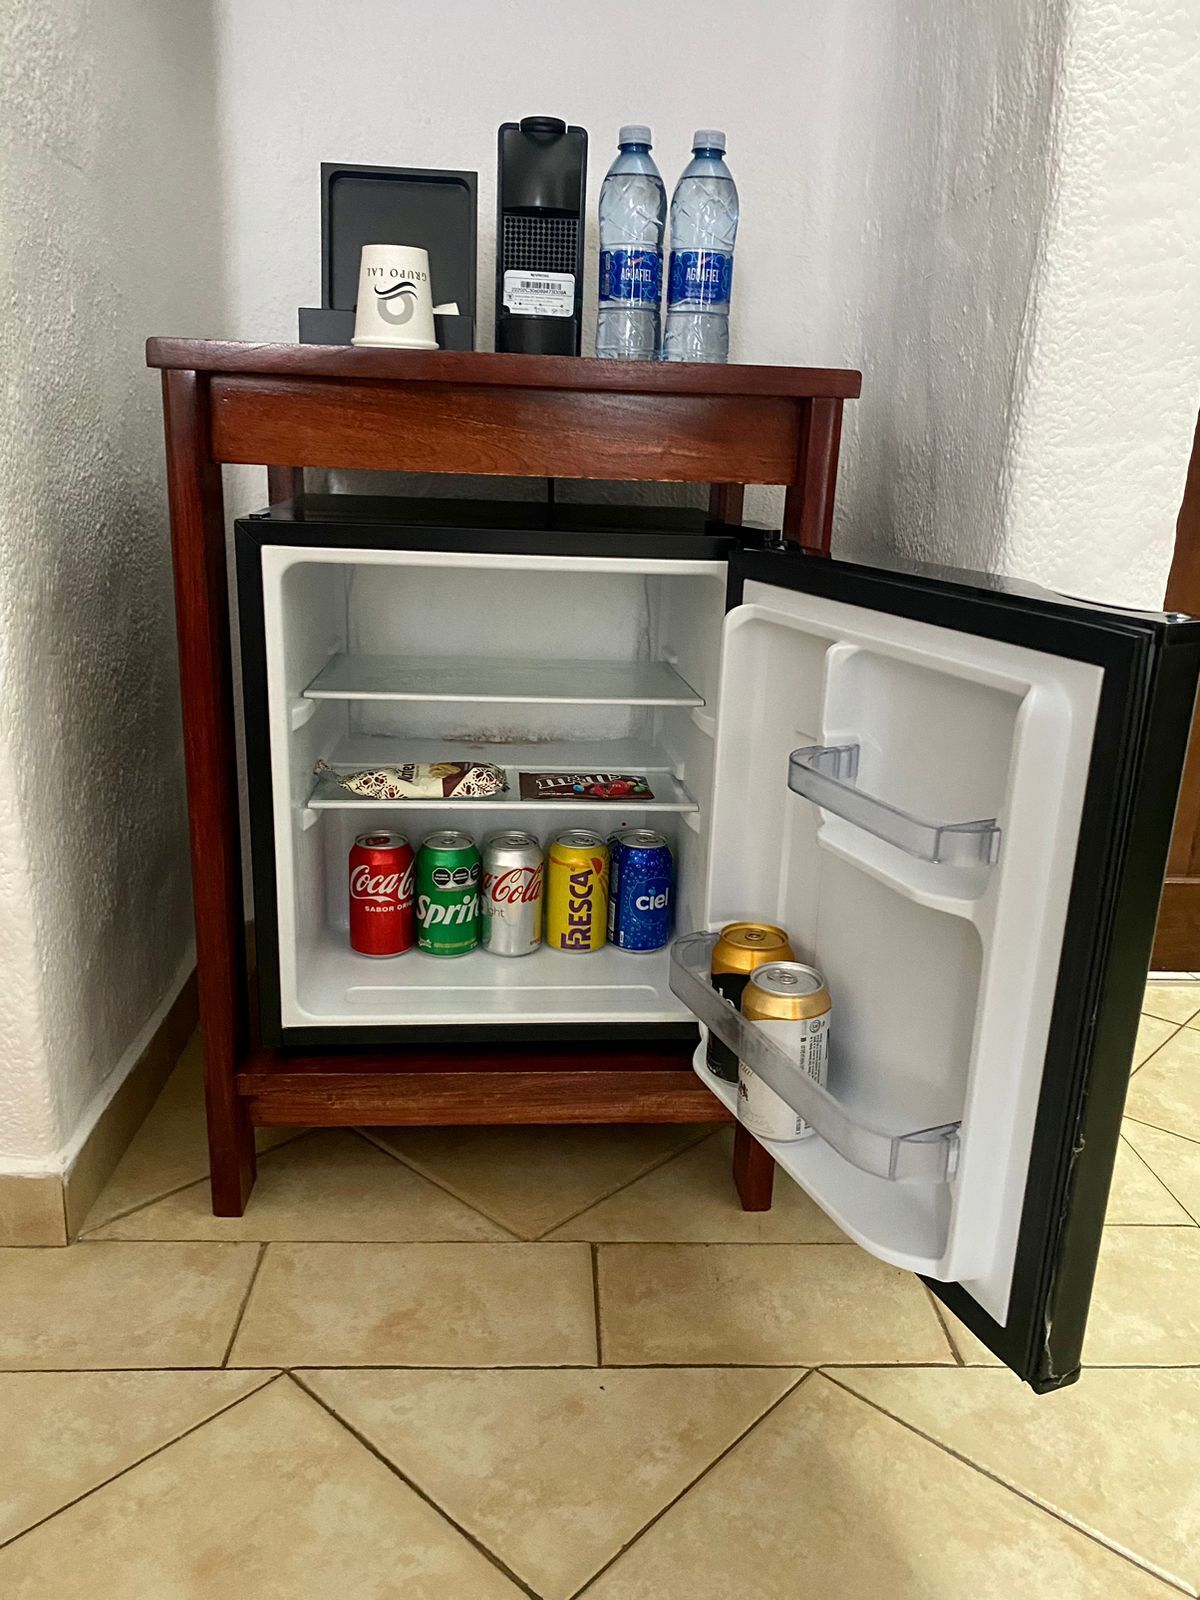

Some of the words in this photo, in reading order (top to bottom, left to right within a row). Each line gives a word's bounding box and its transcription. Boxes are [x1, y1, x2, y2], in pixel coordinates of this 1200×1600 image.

[390, 268, 427, 282] GRUPO
[635, 887, 669, 911] ciel
[364, 905, 395, 913] SABOR
[561, 869, 593, 950] FRESCA
